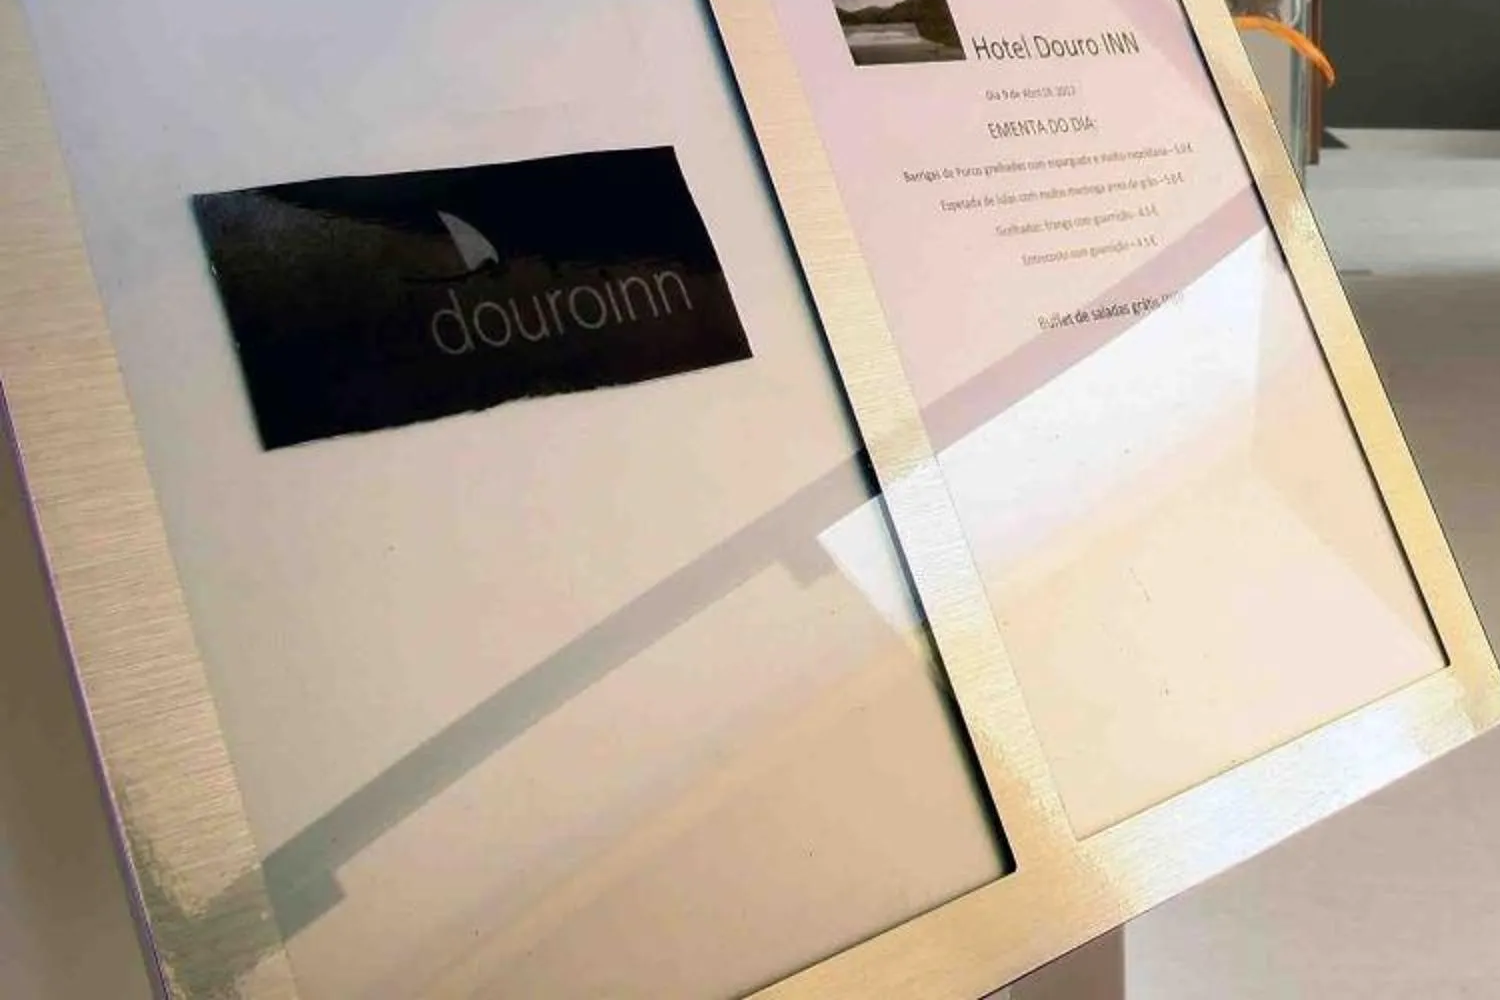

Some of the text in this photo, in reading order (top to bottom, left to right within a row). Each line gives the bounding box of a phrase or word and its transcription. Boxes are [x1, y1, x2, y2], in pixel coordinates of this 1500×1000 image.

[971, 30, 1140, 61] Hotel Douro INN
[987, 118, 1048, 139] EMENTA
[1047, 117, 1069, 135] DO
[431, 268, 694, 358] douroinn
[1074, 307, 1090, 323] de
